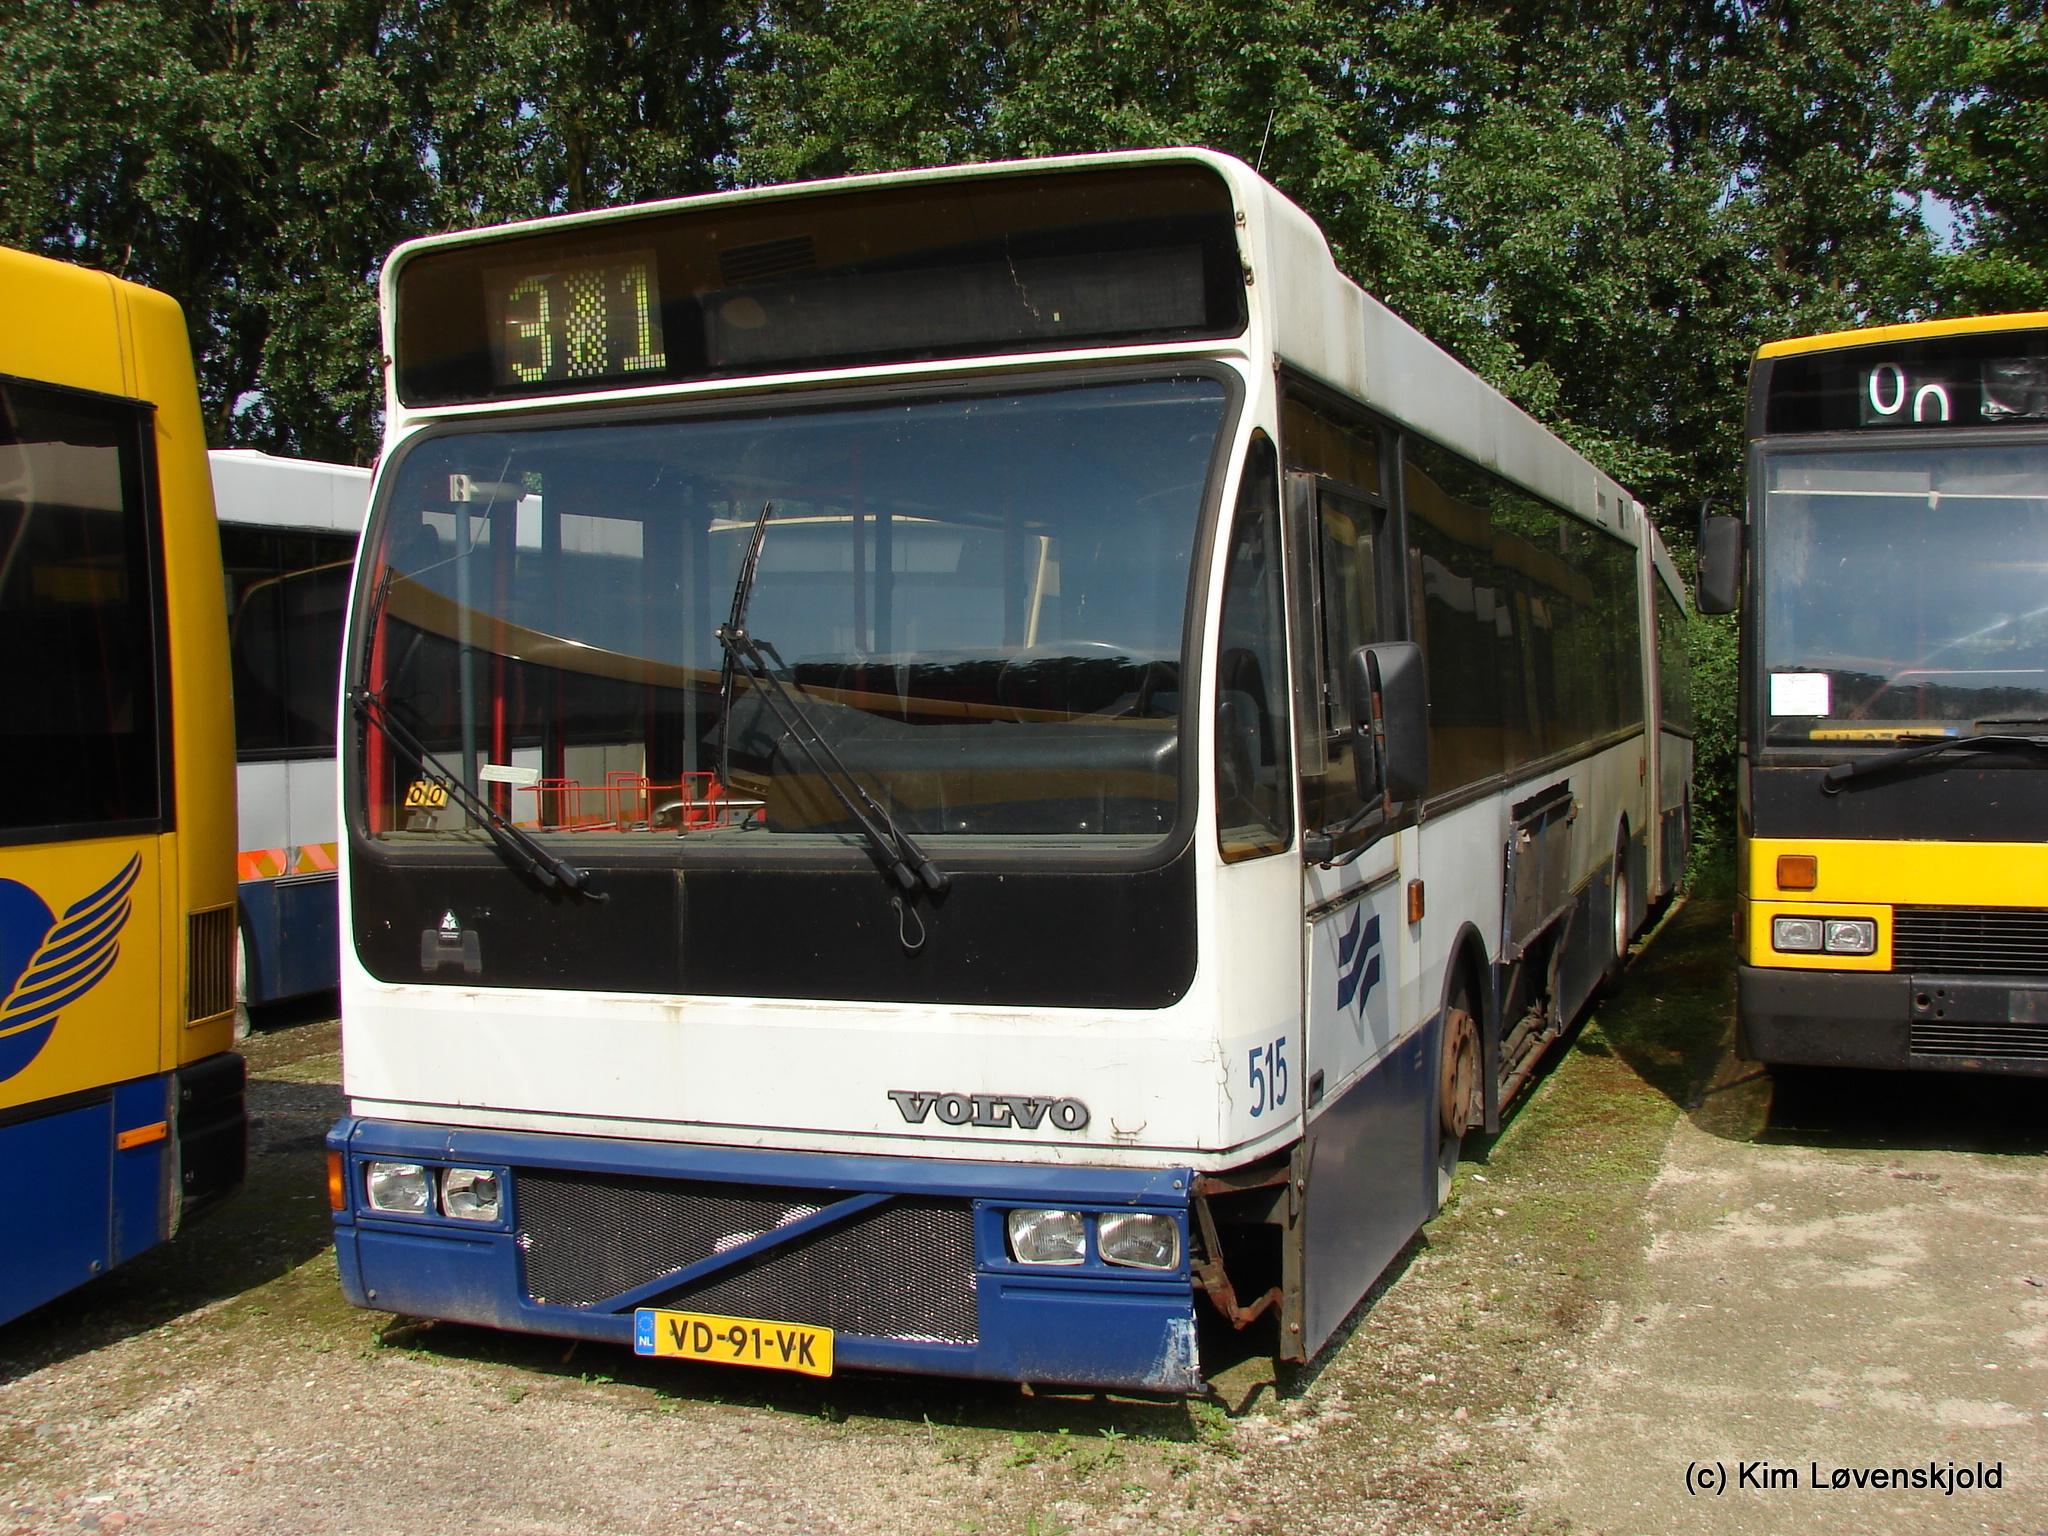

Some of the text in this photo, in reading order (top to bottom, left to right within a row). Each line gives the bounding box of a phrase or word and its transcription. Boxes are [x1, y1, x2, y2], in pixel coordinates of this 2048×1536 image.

[1249, 1036, 1287, 1117] 515
[888, 1090, 1091, 1131] VOLVO
[639, 1335, 653, 1346] NL
[670, 1319, 816, 1367] VD-91-VK
